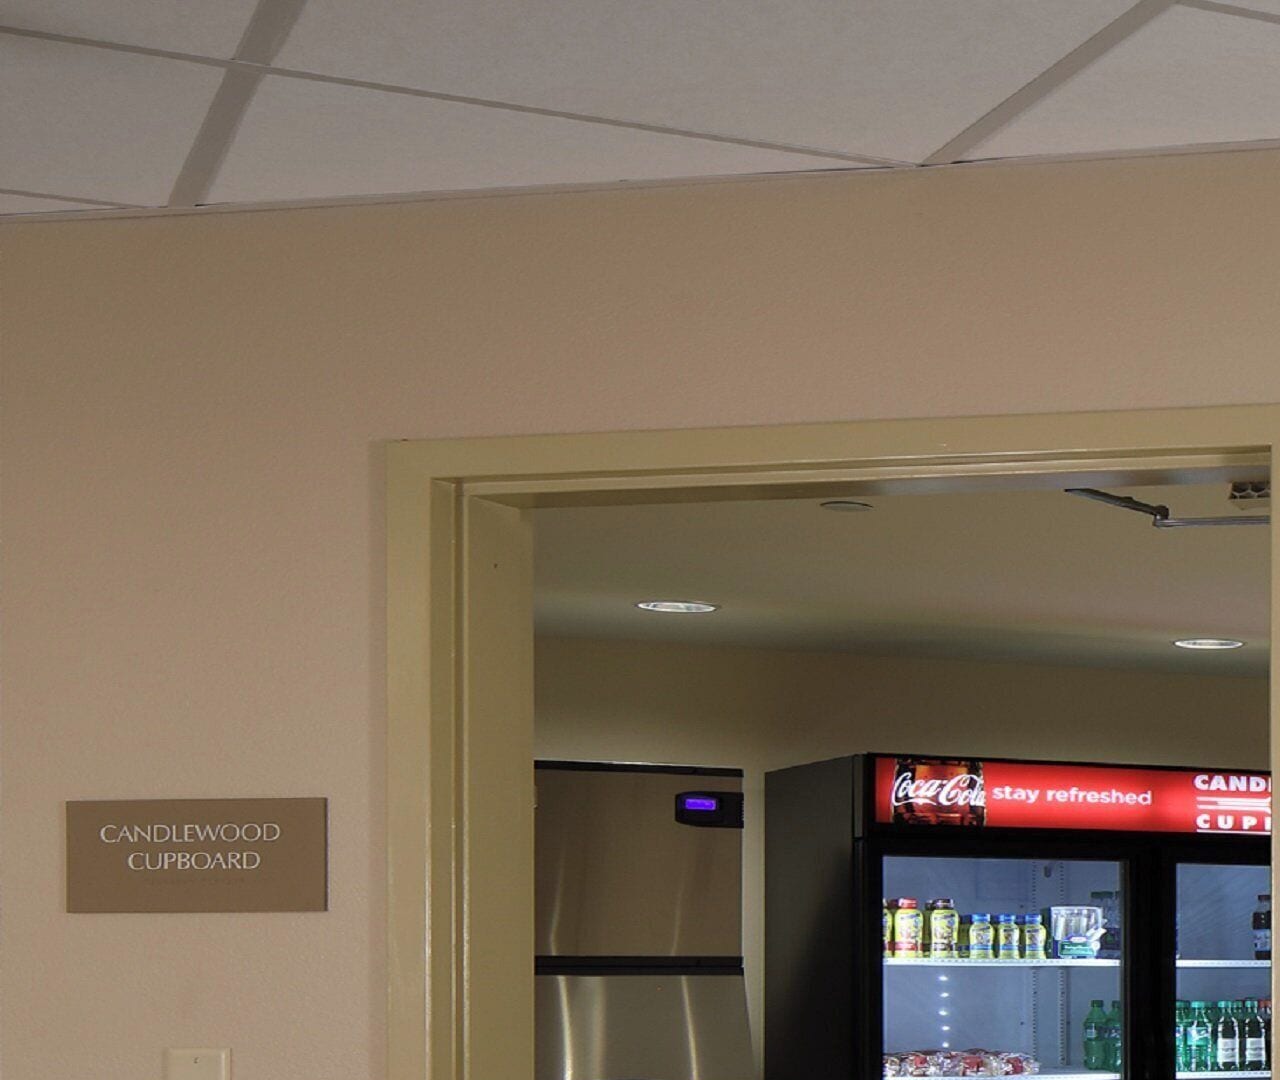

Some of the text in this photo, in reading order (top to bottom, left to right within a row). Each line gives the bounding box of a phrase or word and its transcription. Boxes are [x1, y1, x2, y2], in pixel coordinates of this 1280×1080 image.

[893, 771, 1152, 807] Coca-Cola stay refreshed
[1194, 774, 1271, 793] CAND
[99, 823, 281, 844] CANDLEWOOD
[127, 852, 261, 871] CUPBOARD
